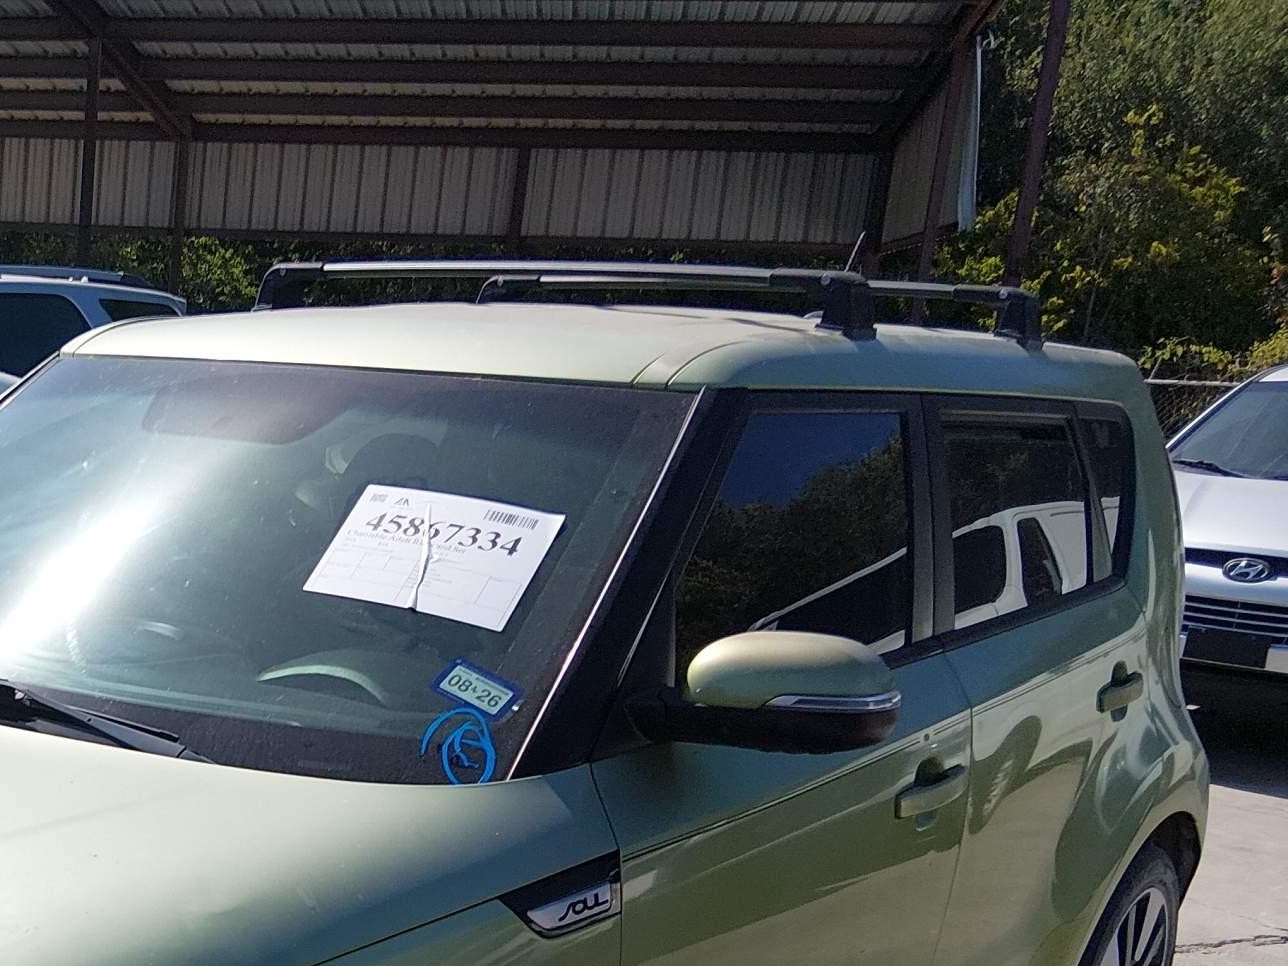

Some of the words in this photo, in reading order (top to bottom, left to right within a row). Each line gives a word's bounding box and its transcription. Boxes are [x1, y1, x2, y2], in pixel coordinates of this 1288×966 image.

[365, 511, 524, 557] 45867334
[447, 674, 473, 693] 08
[474, 688, 503, 708] 26
